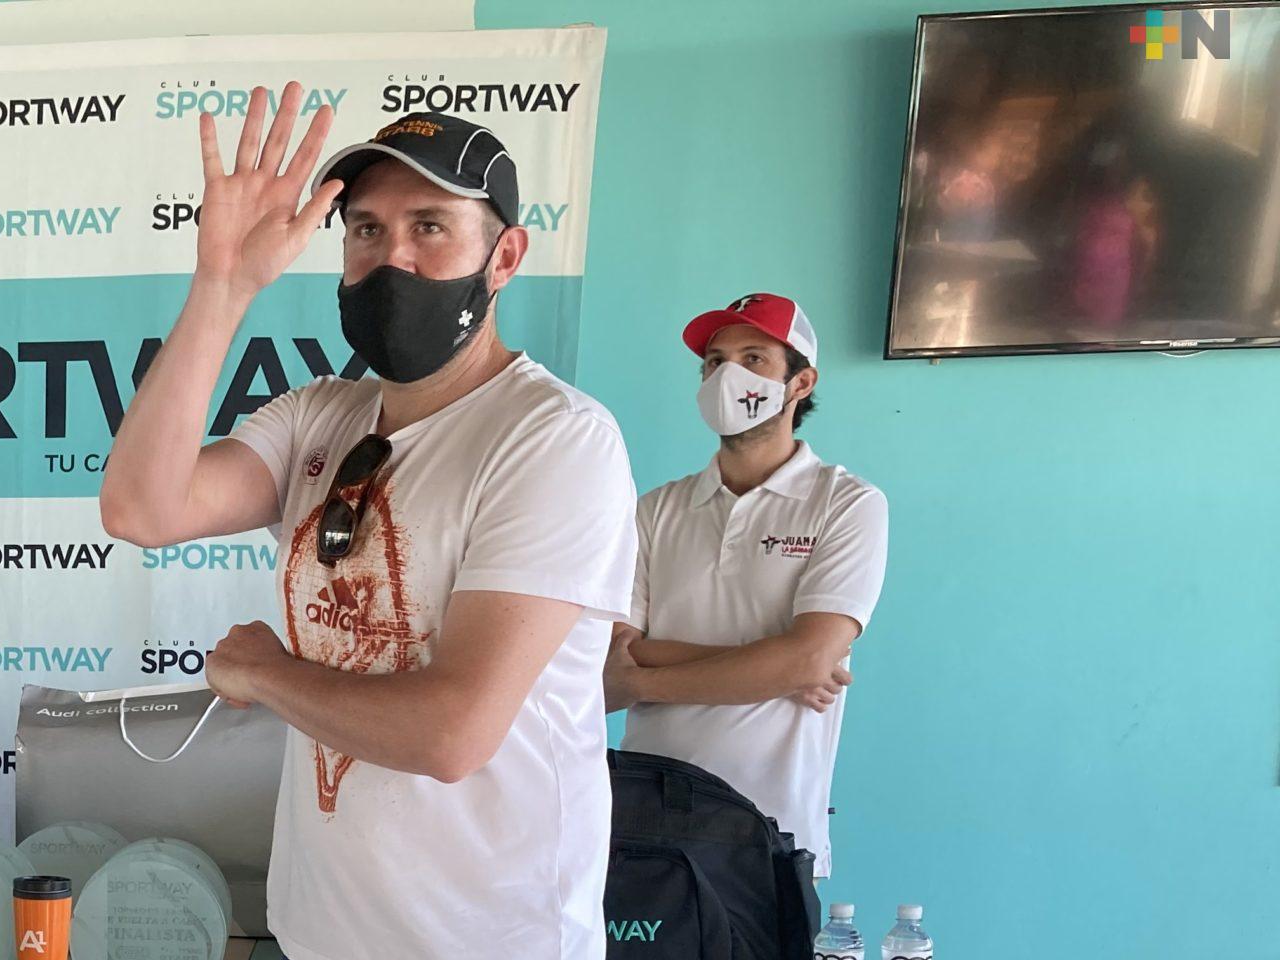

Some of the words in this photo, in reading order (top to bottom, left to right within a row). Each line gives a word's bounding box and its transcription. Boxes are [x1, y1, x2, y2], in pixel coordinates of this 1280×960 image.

[161, 80, 216, 88] CLUB
[388, 74, 445, 82] CLUB
[155, 88, 348, 119] SPORAY
[381, 83, 580, 113] SPORTWAY
[45, 454, 75, 473] TU
[142, 543, 279, 570] SPORTW
[36, 707, 80, 718] Audi
[85, 702, 179, 716] collection
